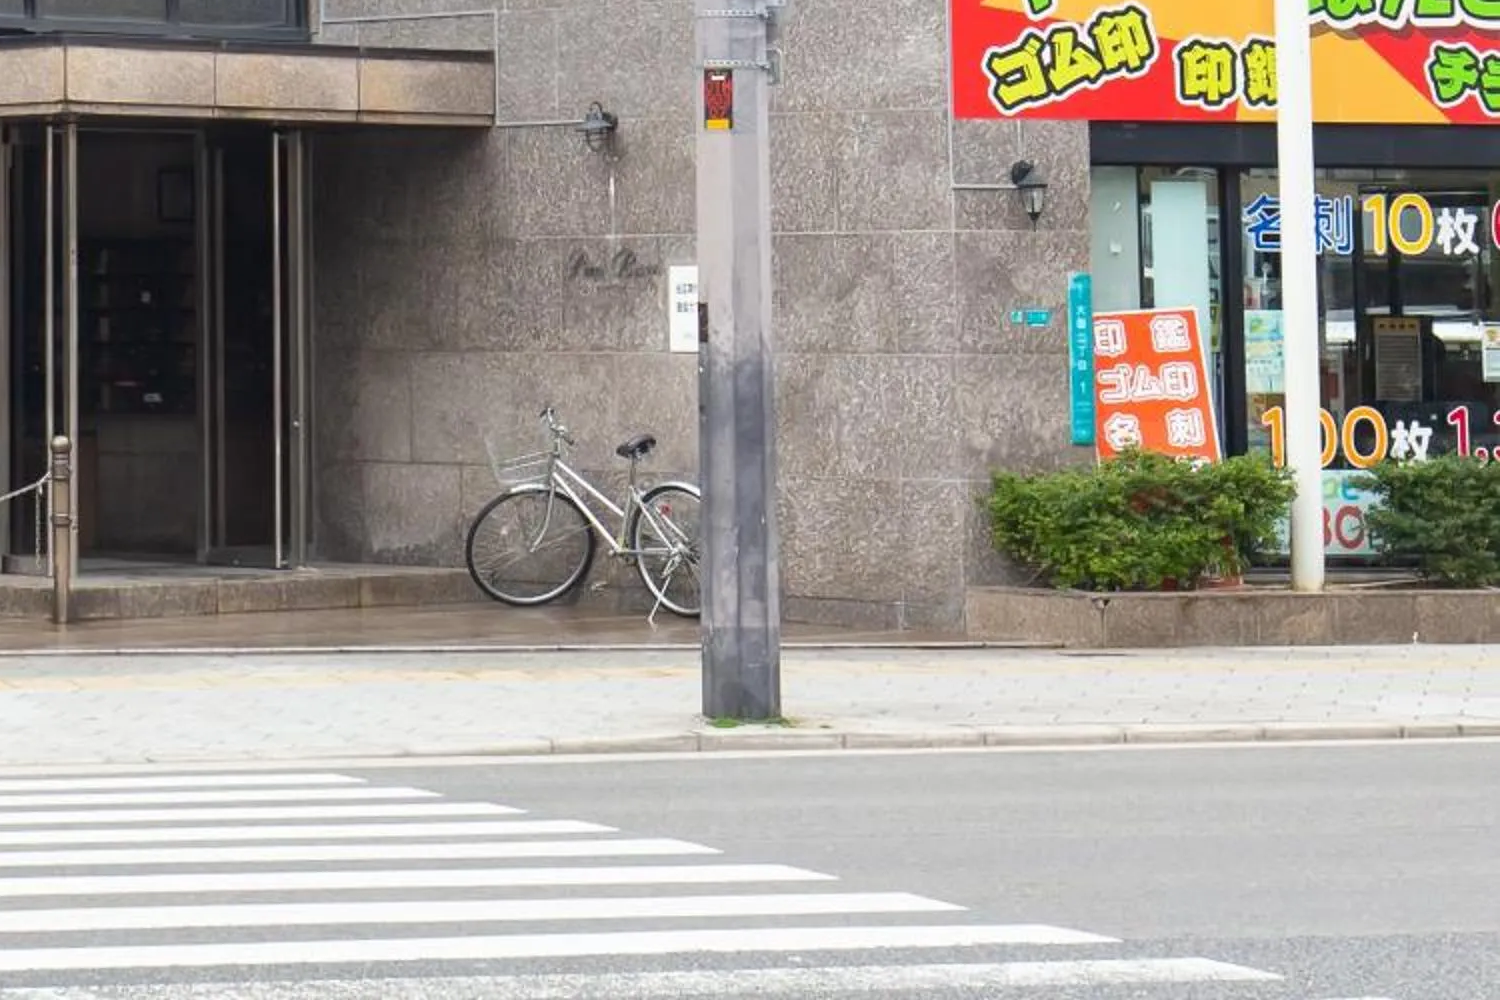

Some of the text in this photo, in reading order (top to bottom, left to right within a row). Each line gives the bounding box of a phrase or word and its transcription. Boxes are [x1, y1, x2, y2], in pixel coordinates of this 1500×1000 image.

[987, 6, 1156, 108] ゴム印
[1243, 192, 1353, 255] 名刺
[1098, 362, 1199, 404] ゴム印
